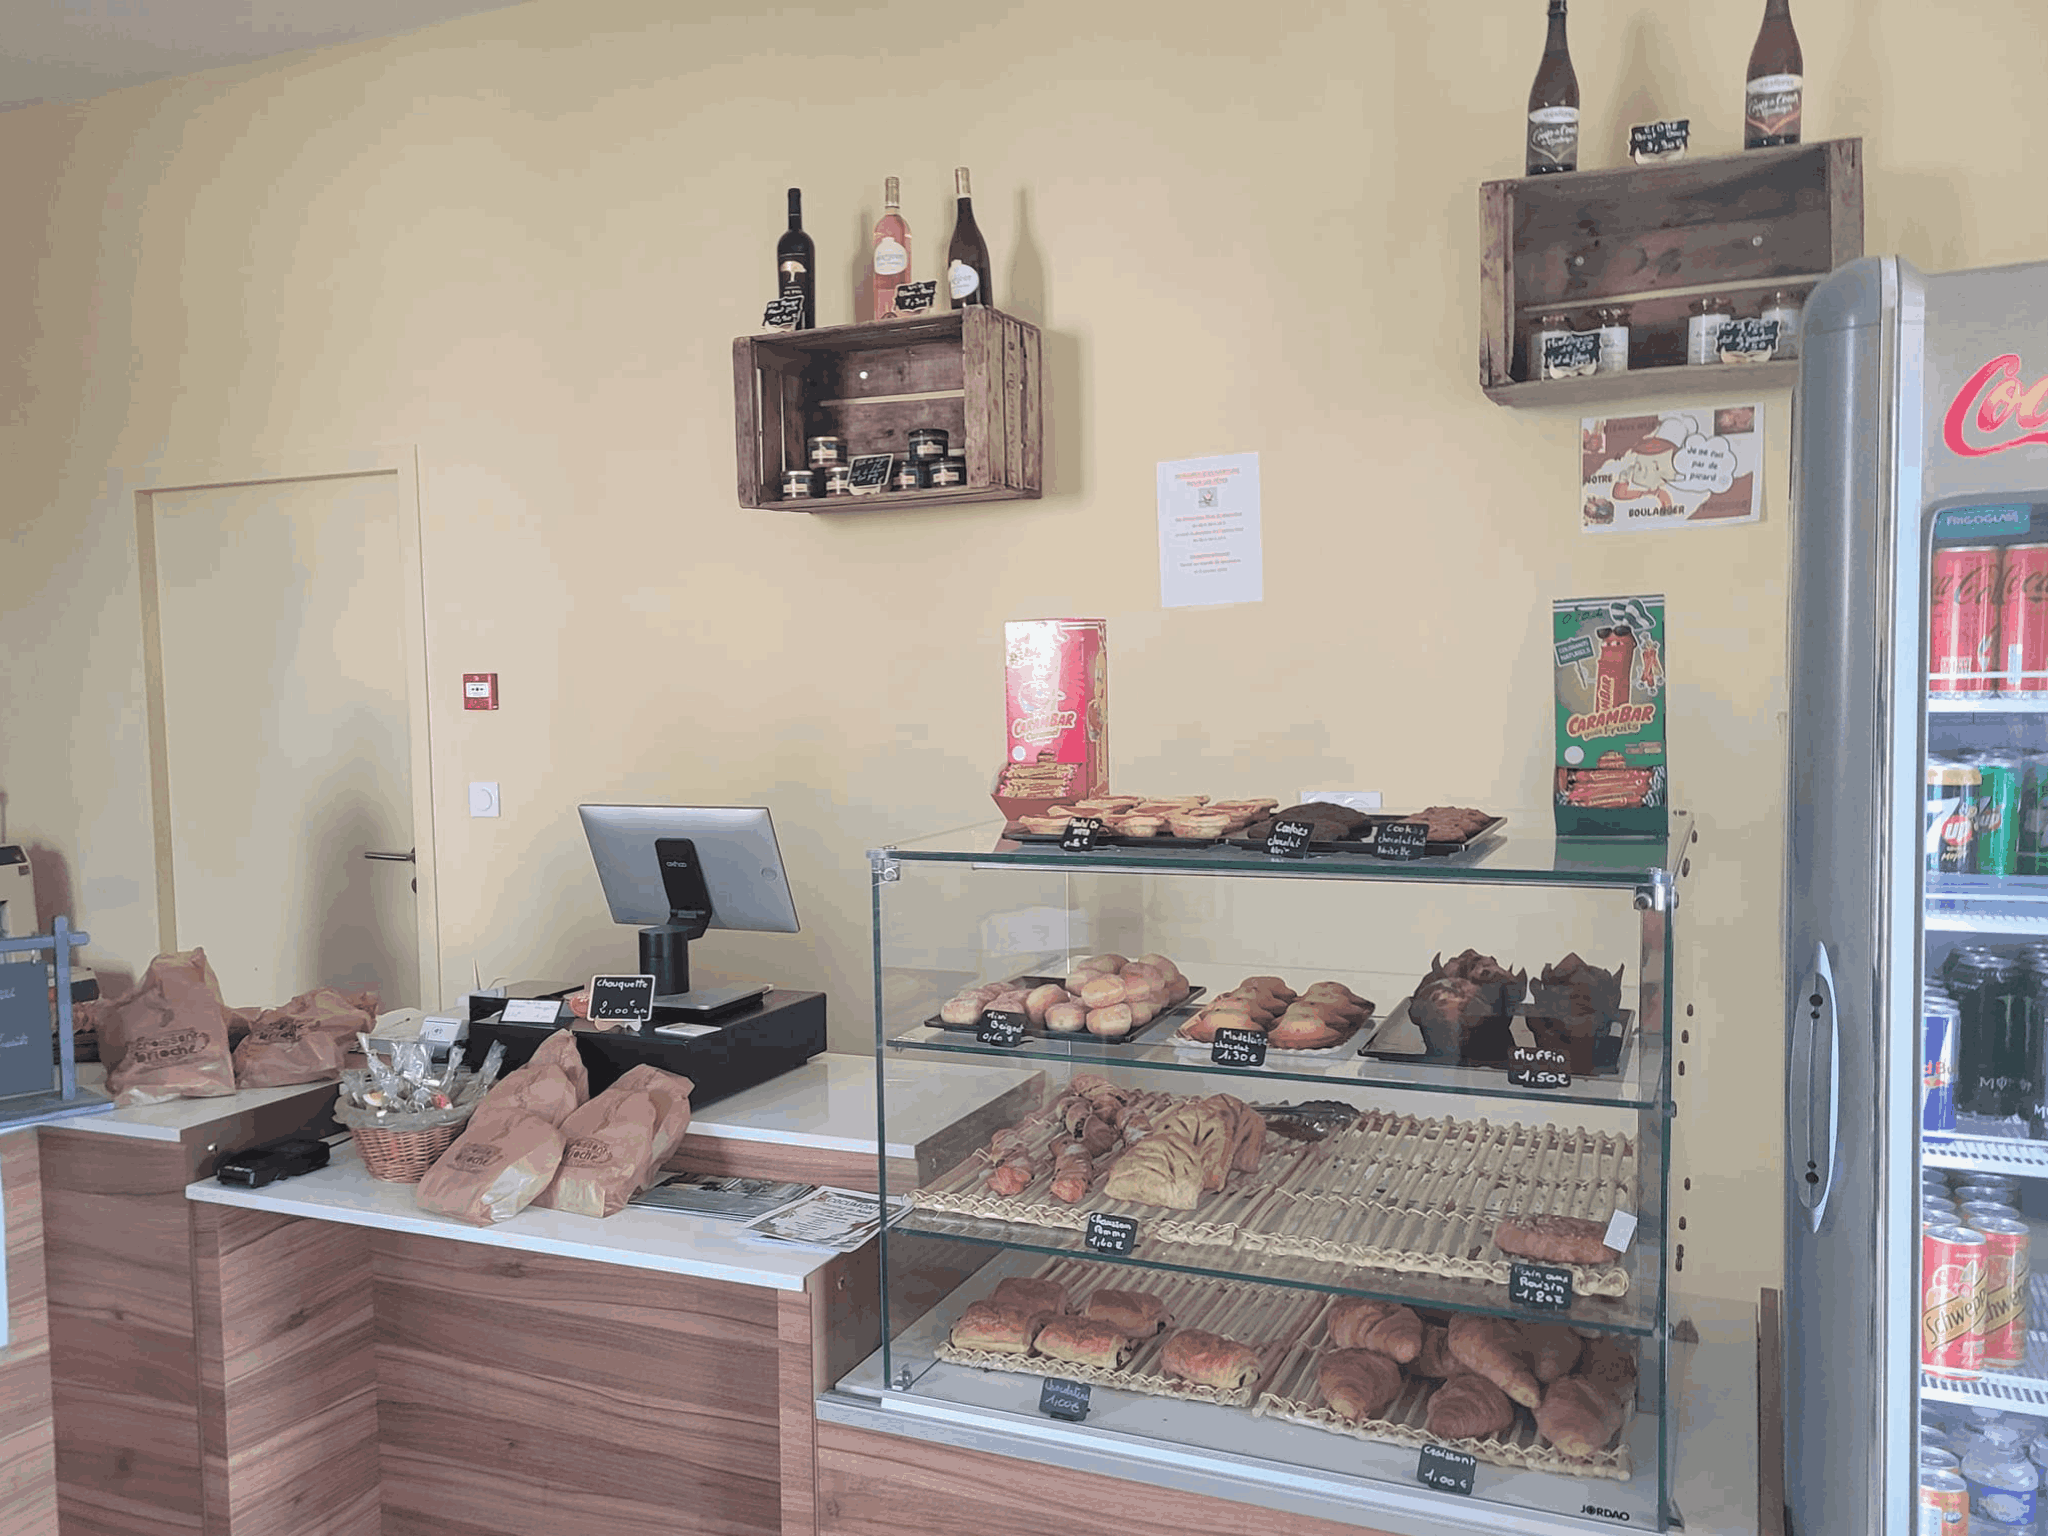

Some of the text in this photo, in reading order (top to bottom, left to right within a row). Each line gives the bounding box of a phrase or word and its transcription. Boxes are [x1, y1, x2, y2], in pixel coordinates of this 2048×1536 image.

[1584, 474, 1613, 485] NOTRE
[1628, 505, 1685, 518] BOULANGER
[1568, 705, 1654, 737] CARAMBAR
[1604, 722, 1640, 736] Fruits
[1275, 821, 1308, 836] Cookies
[1267, 833, 1300, 848] chocolat
[1377, 832, 1411, 845] chocolat
[597, 978, 648, 991] Chouquette
[990, 1020, 1024, 1035] Beignet
[1215, 1040, 1250, 1053] chocolat
[1514, 1048, 1565, 1064] Muffin
[1090, 1214, 1132, 1231] Chausson
[1094, 1224, 1126, 1239] Pomme
[1519, 1276, 1564, 1294] Raisin
